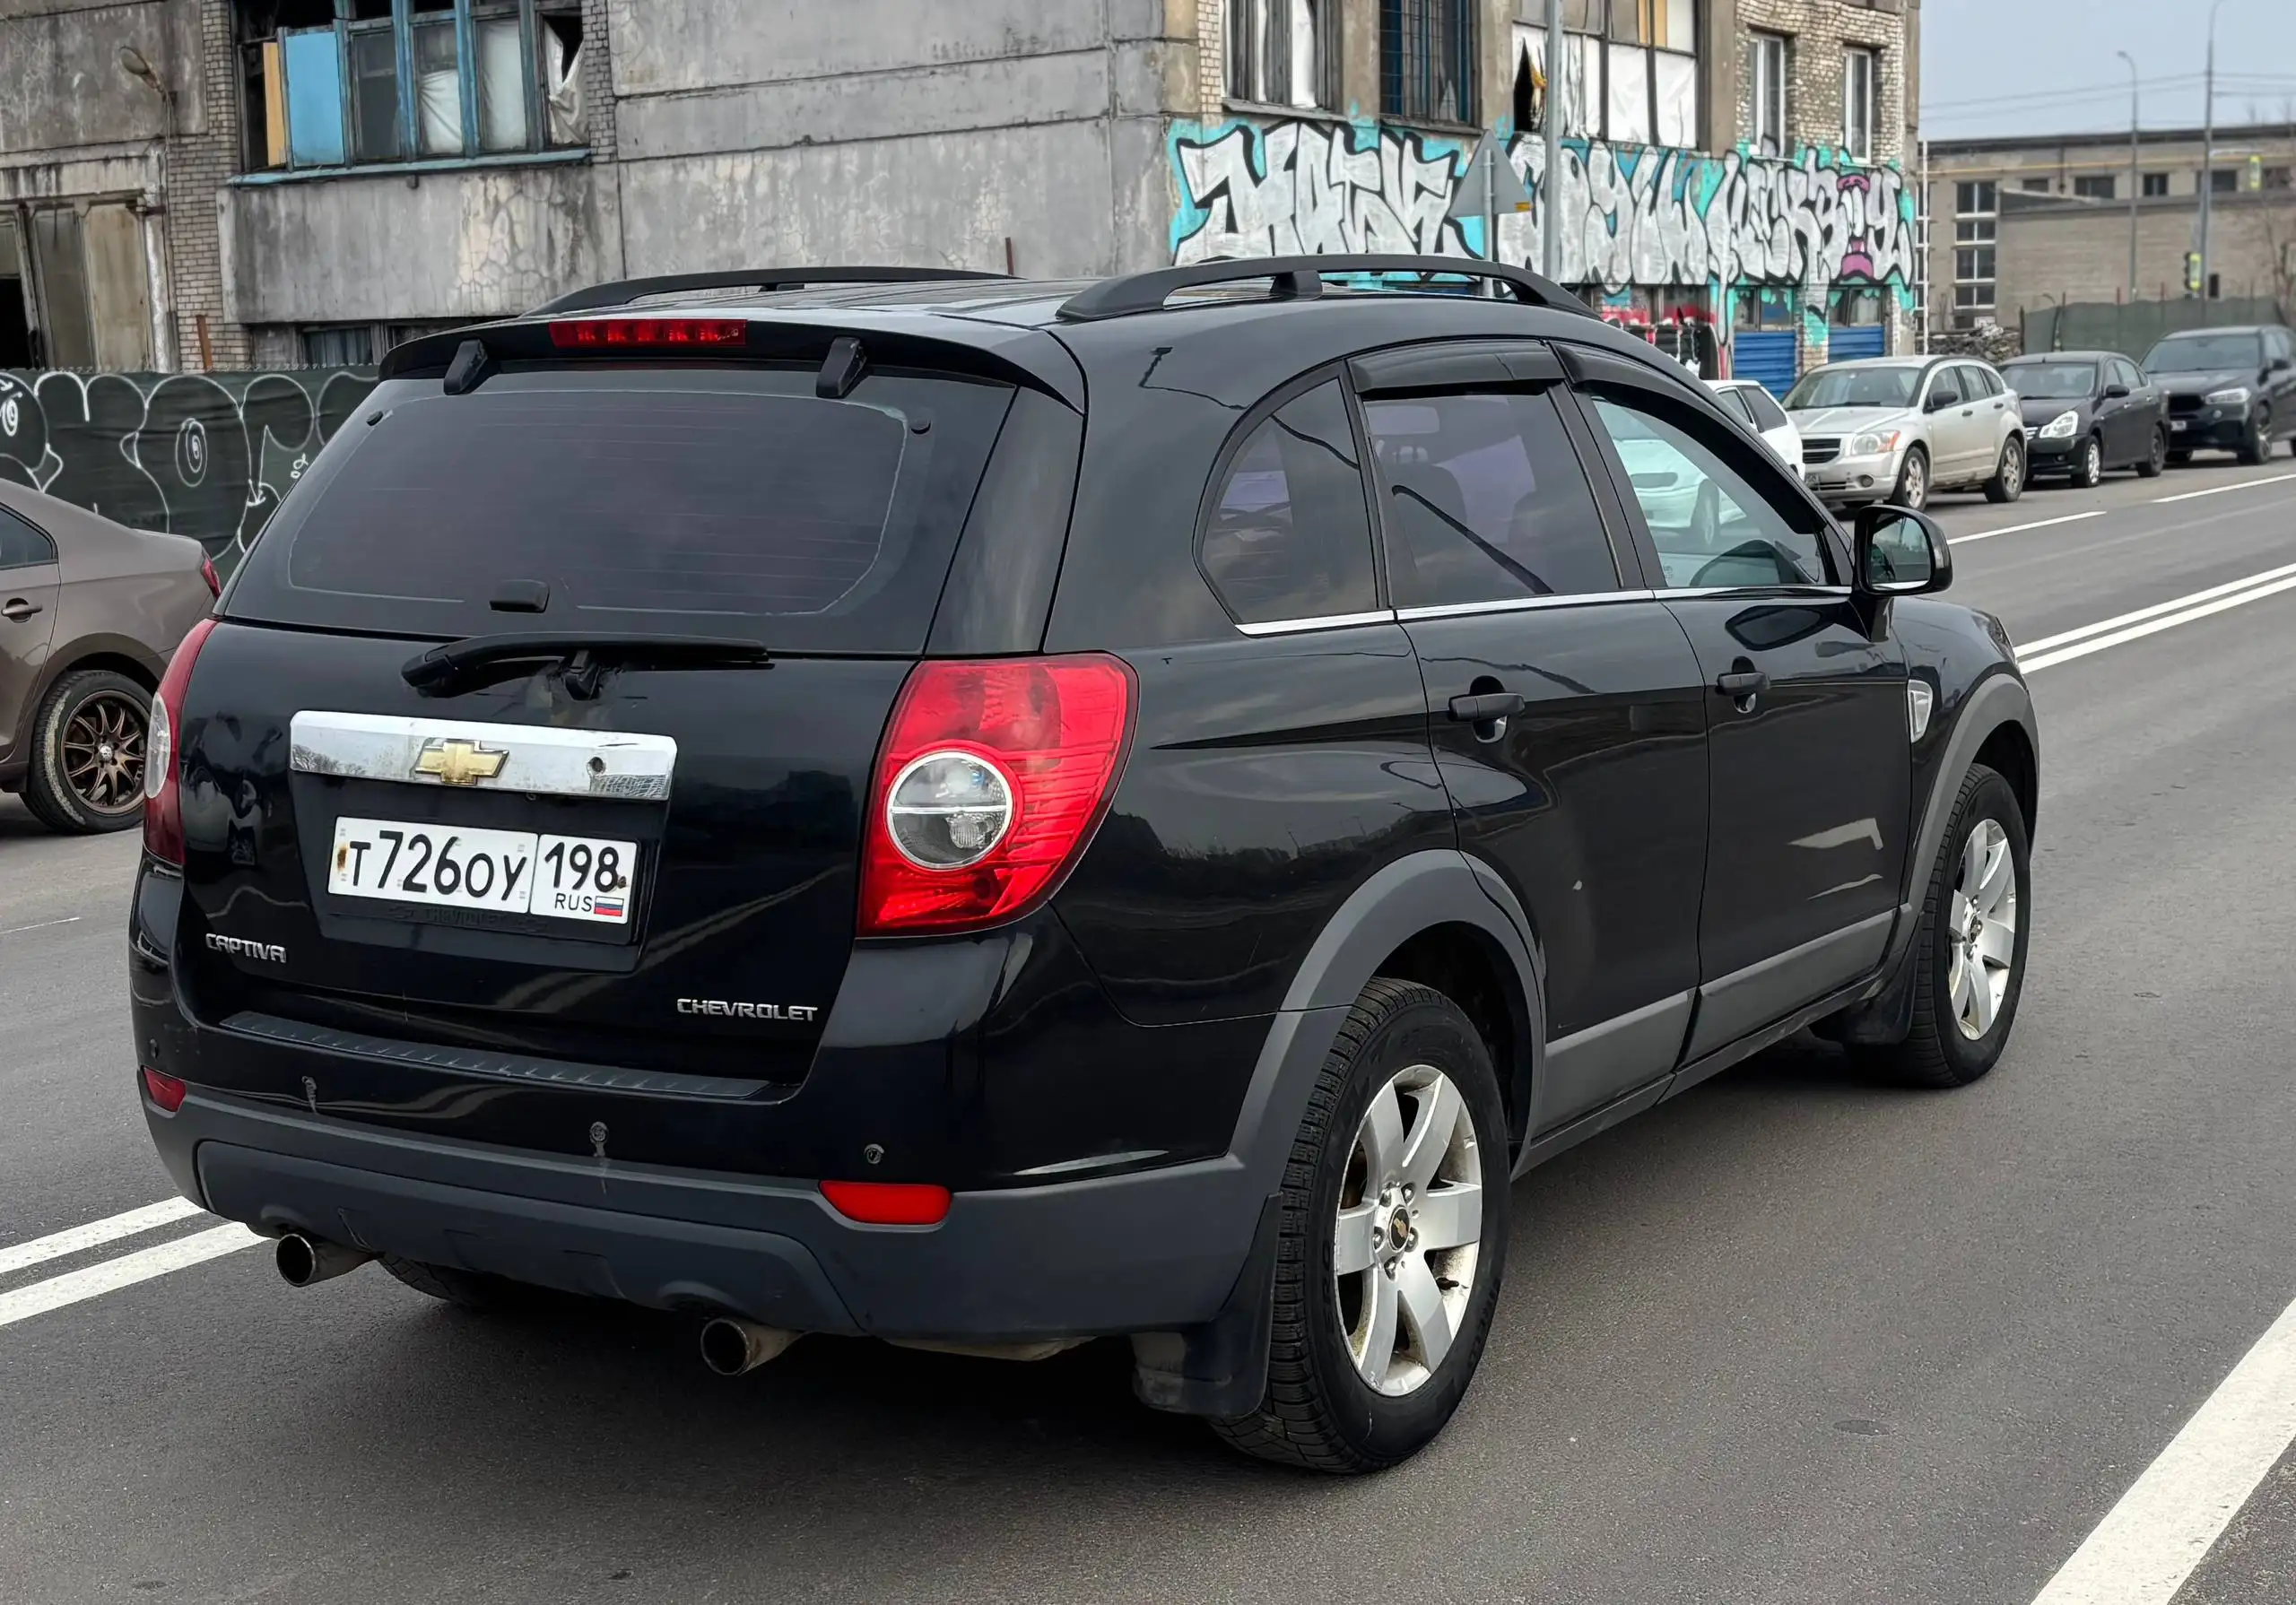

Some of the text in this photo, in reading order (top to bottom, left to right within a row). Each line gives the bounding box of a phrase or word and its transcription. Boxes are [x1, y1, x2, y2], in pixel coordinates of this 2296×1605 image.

[544, 842, 620, 893] 198
[553, 892, 593, 913] RUS
[205, 933, 287, 963] CAPTIVA
[677, 998, 818, 1021] CHEVROLET
